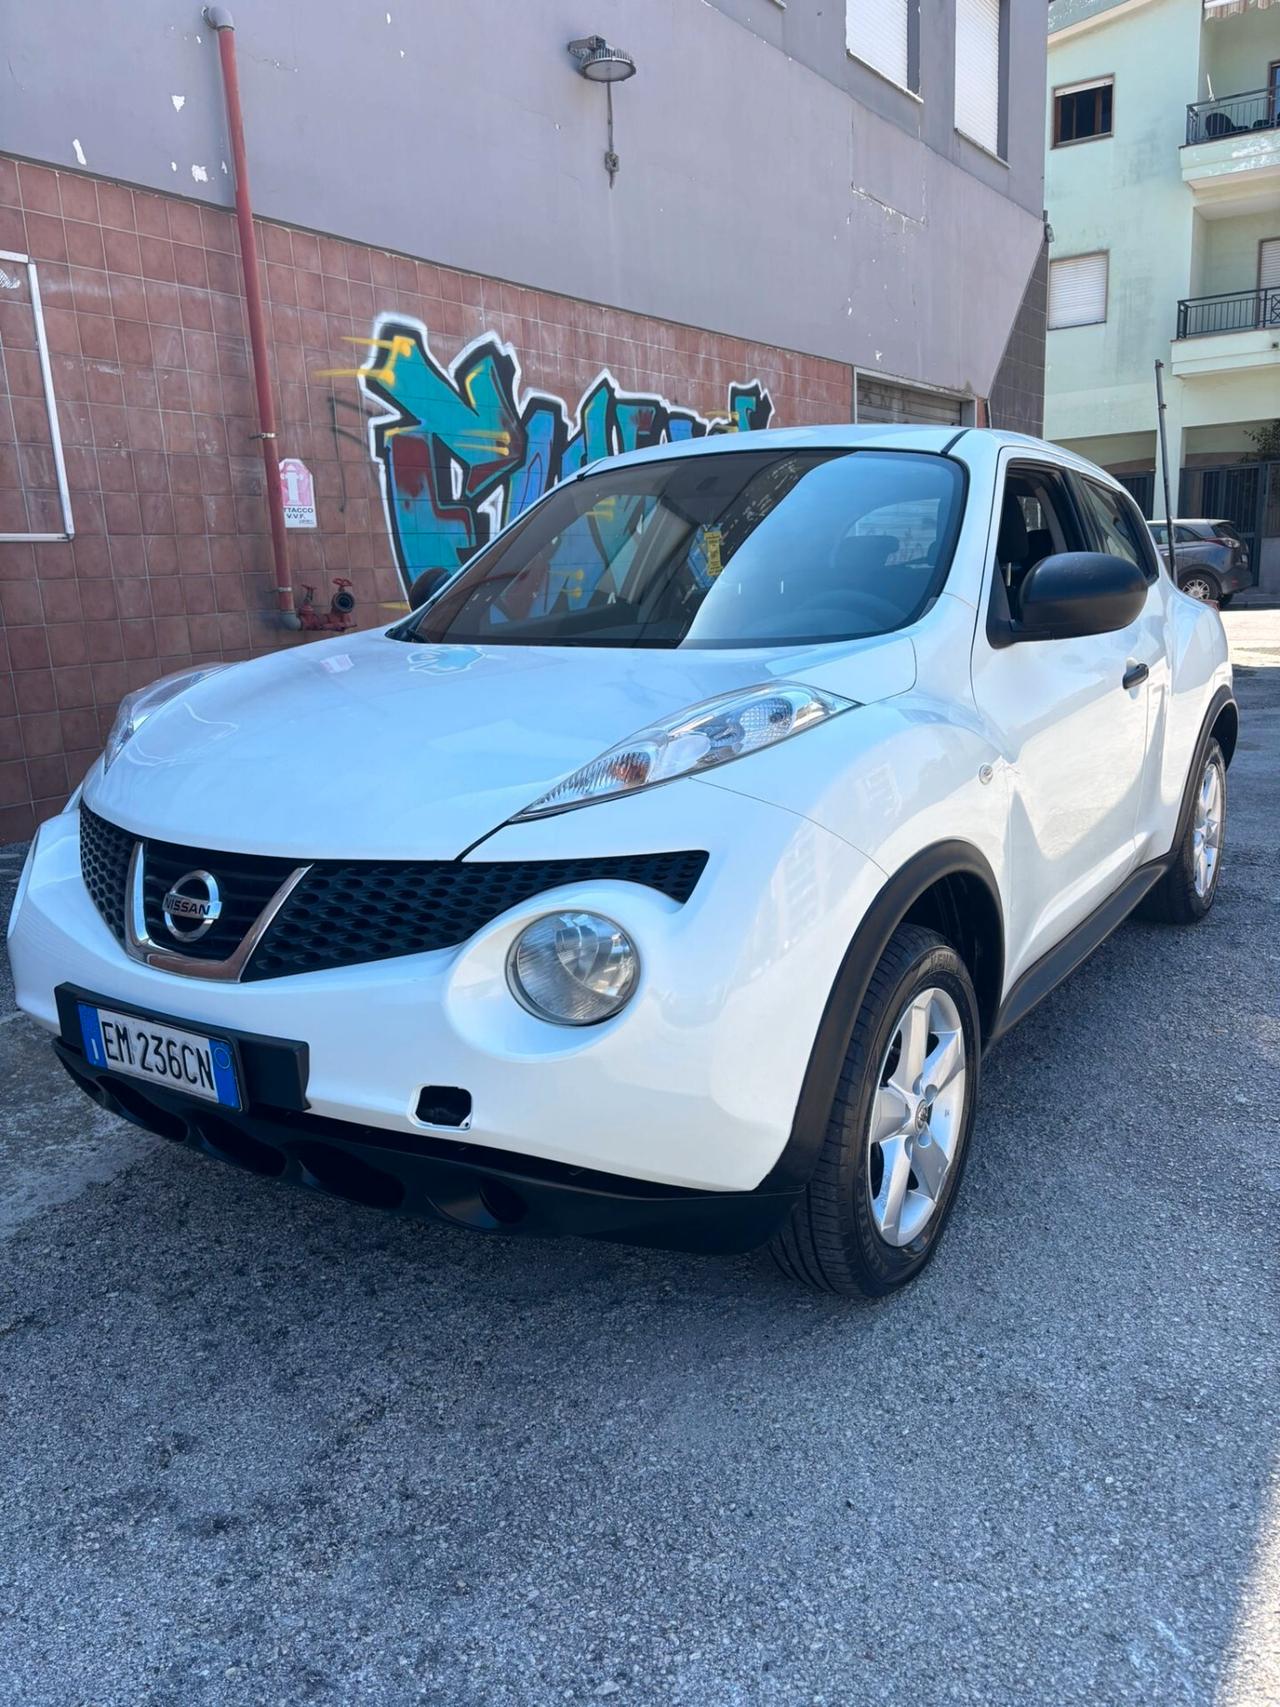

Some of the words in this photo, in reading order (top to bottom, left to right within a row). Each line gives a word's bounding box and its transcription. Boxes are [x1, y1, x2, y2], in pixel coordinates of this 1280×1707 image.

[165, 894, 211, 915] NISSAN
[101, 1021, 134, 1065] EM
[136, 1032, 215, 1091] 236CN
